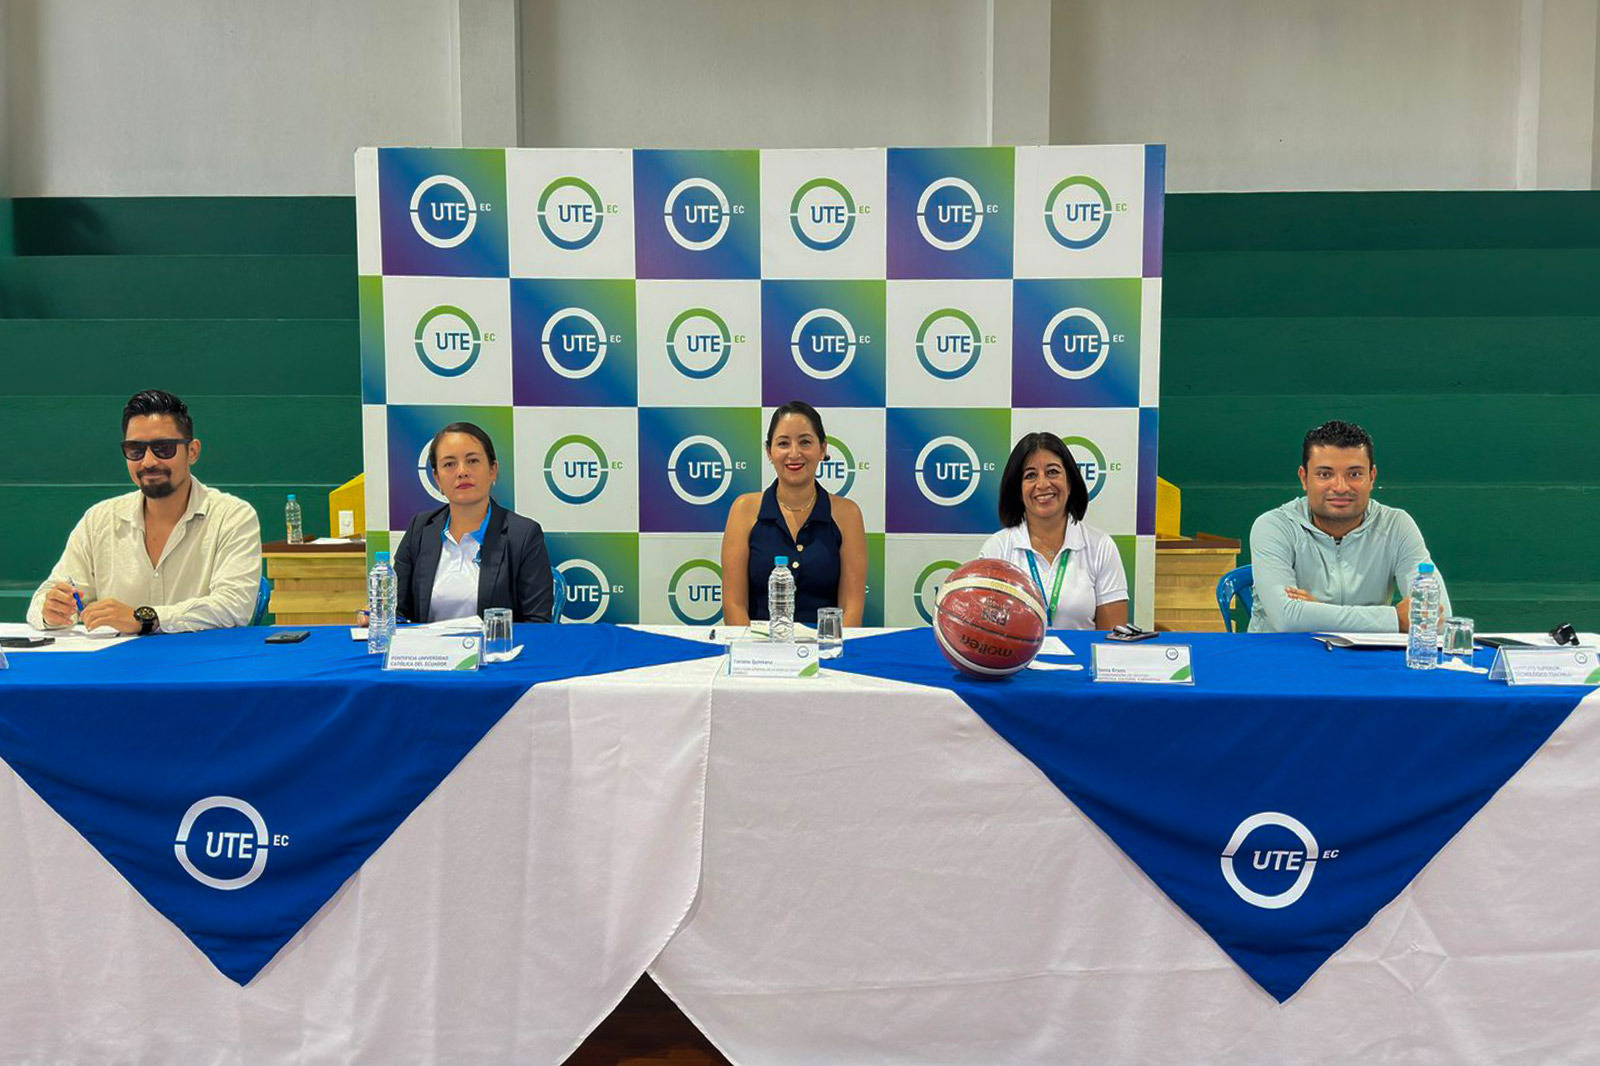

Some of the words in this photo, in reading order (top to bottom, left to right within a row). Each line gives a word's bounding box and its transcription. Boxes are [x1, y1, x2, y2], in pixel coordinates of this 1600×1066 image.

[431, 203, 466, 221] UTE
[558, 204, 593, 223] UTE
[606, 205, 618, 213] EC
[685, 206, 719, 224] UTE
[732, 206, 744, 214] EC
[811, 206, 845, 223] UTE
[938, 206, 972, 223] UTE
[987, 205, 998, 213] EC
[1066, 204, 1101, 222] UTE
[436, 333, 470, 351] UTE
[484, 333, 495, 341] EC
[562, 335, 596, 352] UTE
[610, 335, 621, 343] EC
[687, 335, 720, 352] UTE
[735, 335, 745, 343] EC
[812, 336, 845, 352] UTE
[937, 336, 971, 352] UTE
[1064, 335, 1098, 352] UTE
[565, 461, 598, 478] UTE
[612, 461, 622, 469] EC
[688, 462, 721, 478] UTE
[936, 463, 969, 479] UTE
[566, 586, 599, 602] UTE
[688, 586, 721, 602] UTE
[962, 633, 1013, 658] molten
[206, 831, 253, 858] UTE
[273, 834, 289, 846] EC
[1253, 850, 1303, 871] UTE
[1323, 849, 1339, 859] EC
